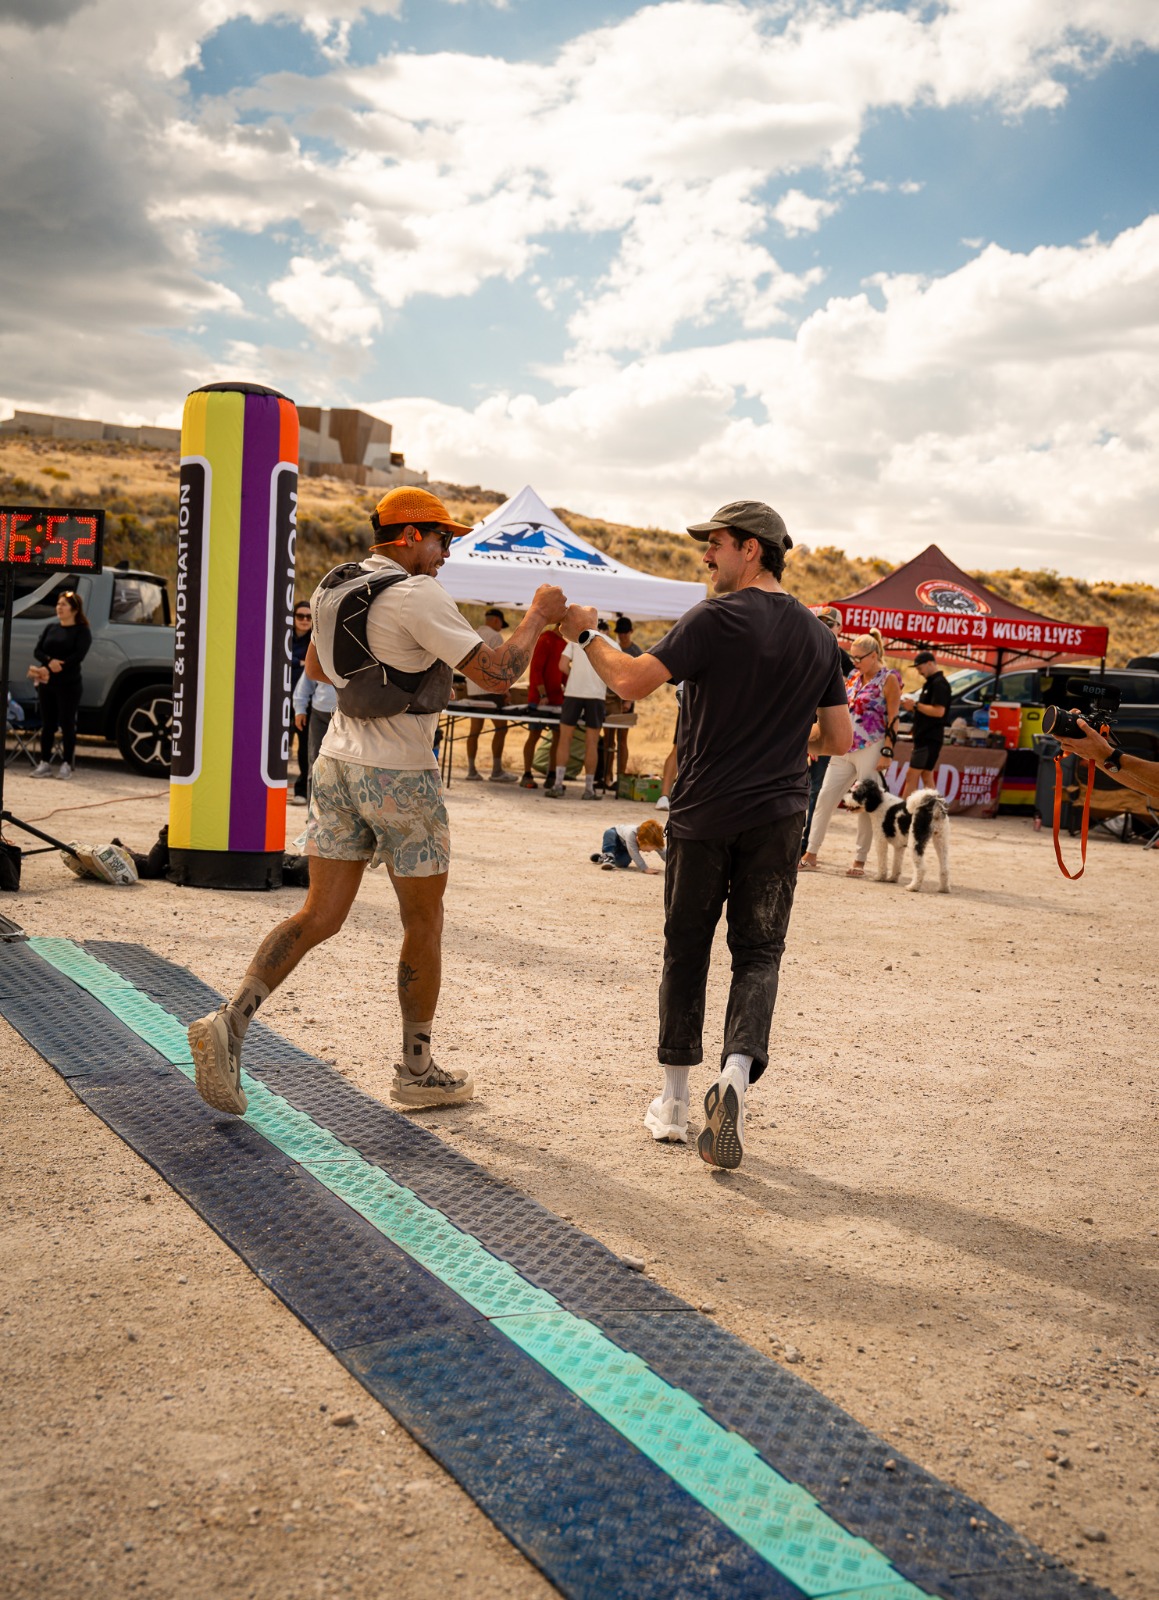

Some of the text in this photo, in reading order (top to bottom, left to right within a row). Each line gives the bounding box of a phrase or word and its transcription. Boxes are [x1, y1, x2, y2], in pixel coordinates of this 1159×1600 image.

[468, 552, 618, 573] Park City Rotary
[171, 484, 192, 757] FUEL & HYDRATION
[845, 607, 904, 631] FEEDING
[906, 613, 935, 633] EPIC
[937, 616, 970, 636] DAYS
[992, 621, 1041, 643] WILDER
[963, 766, 984, 775] WHAT
[971, 775, 977, 785] A
